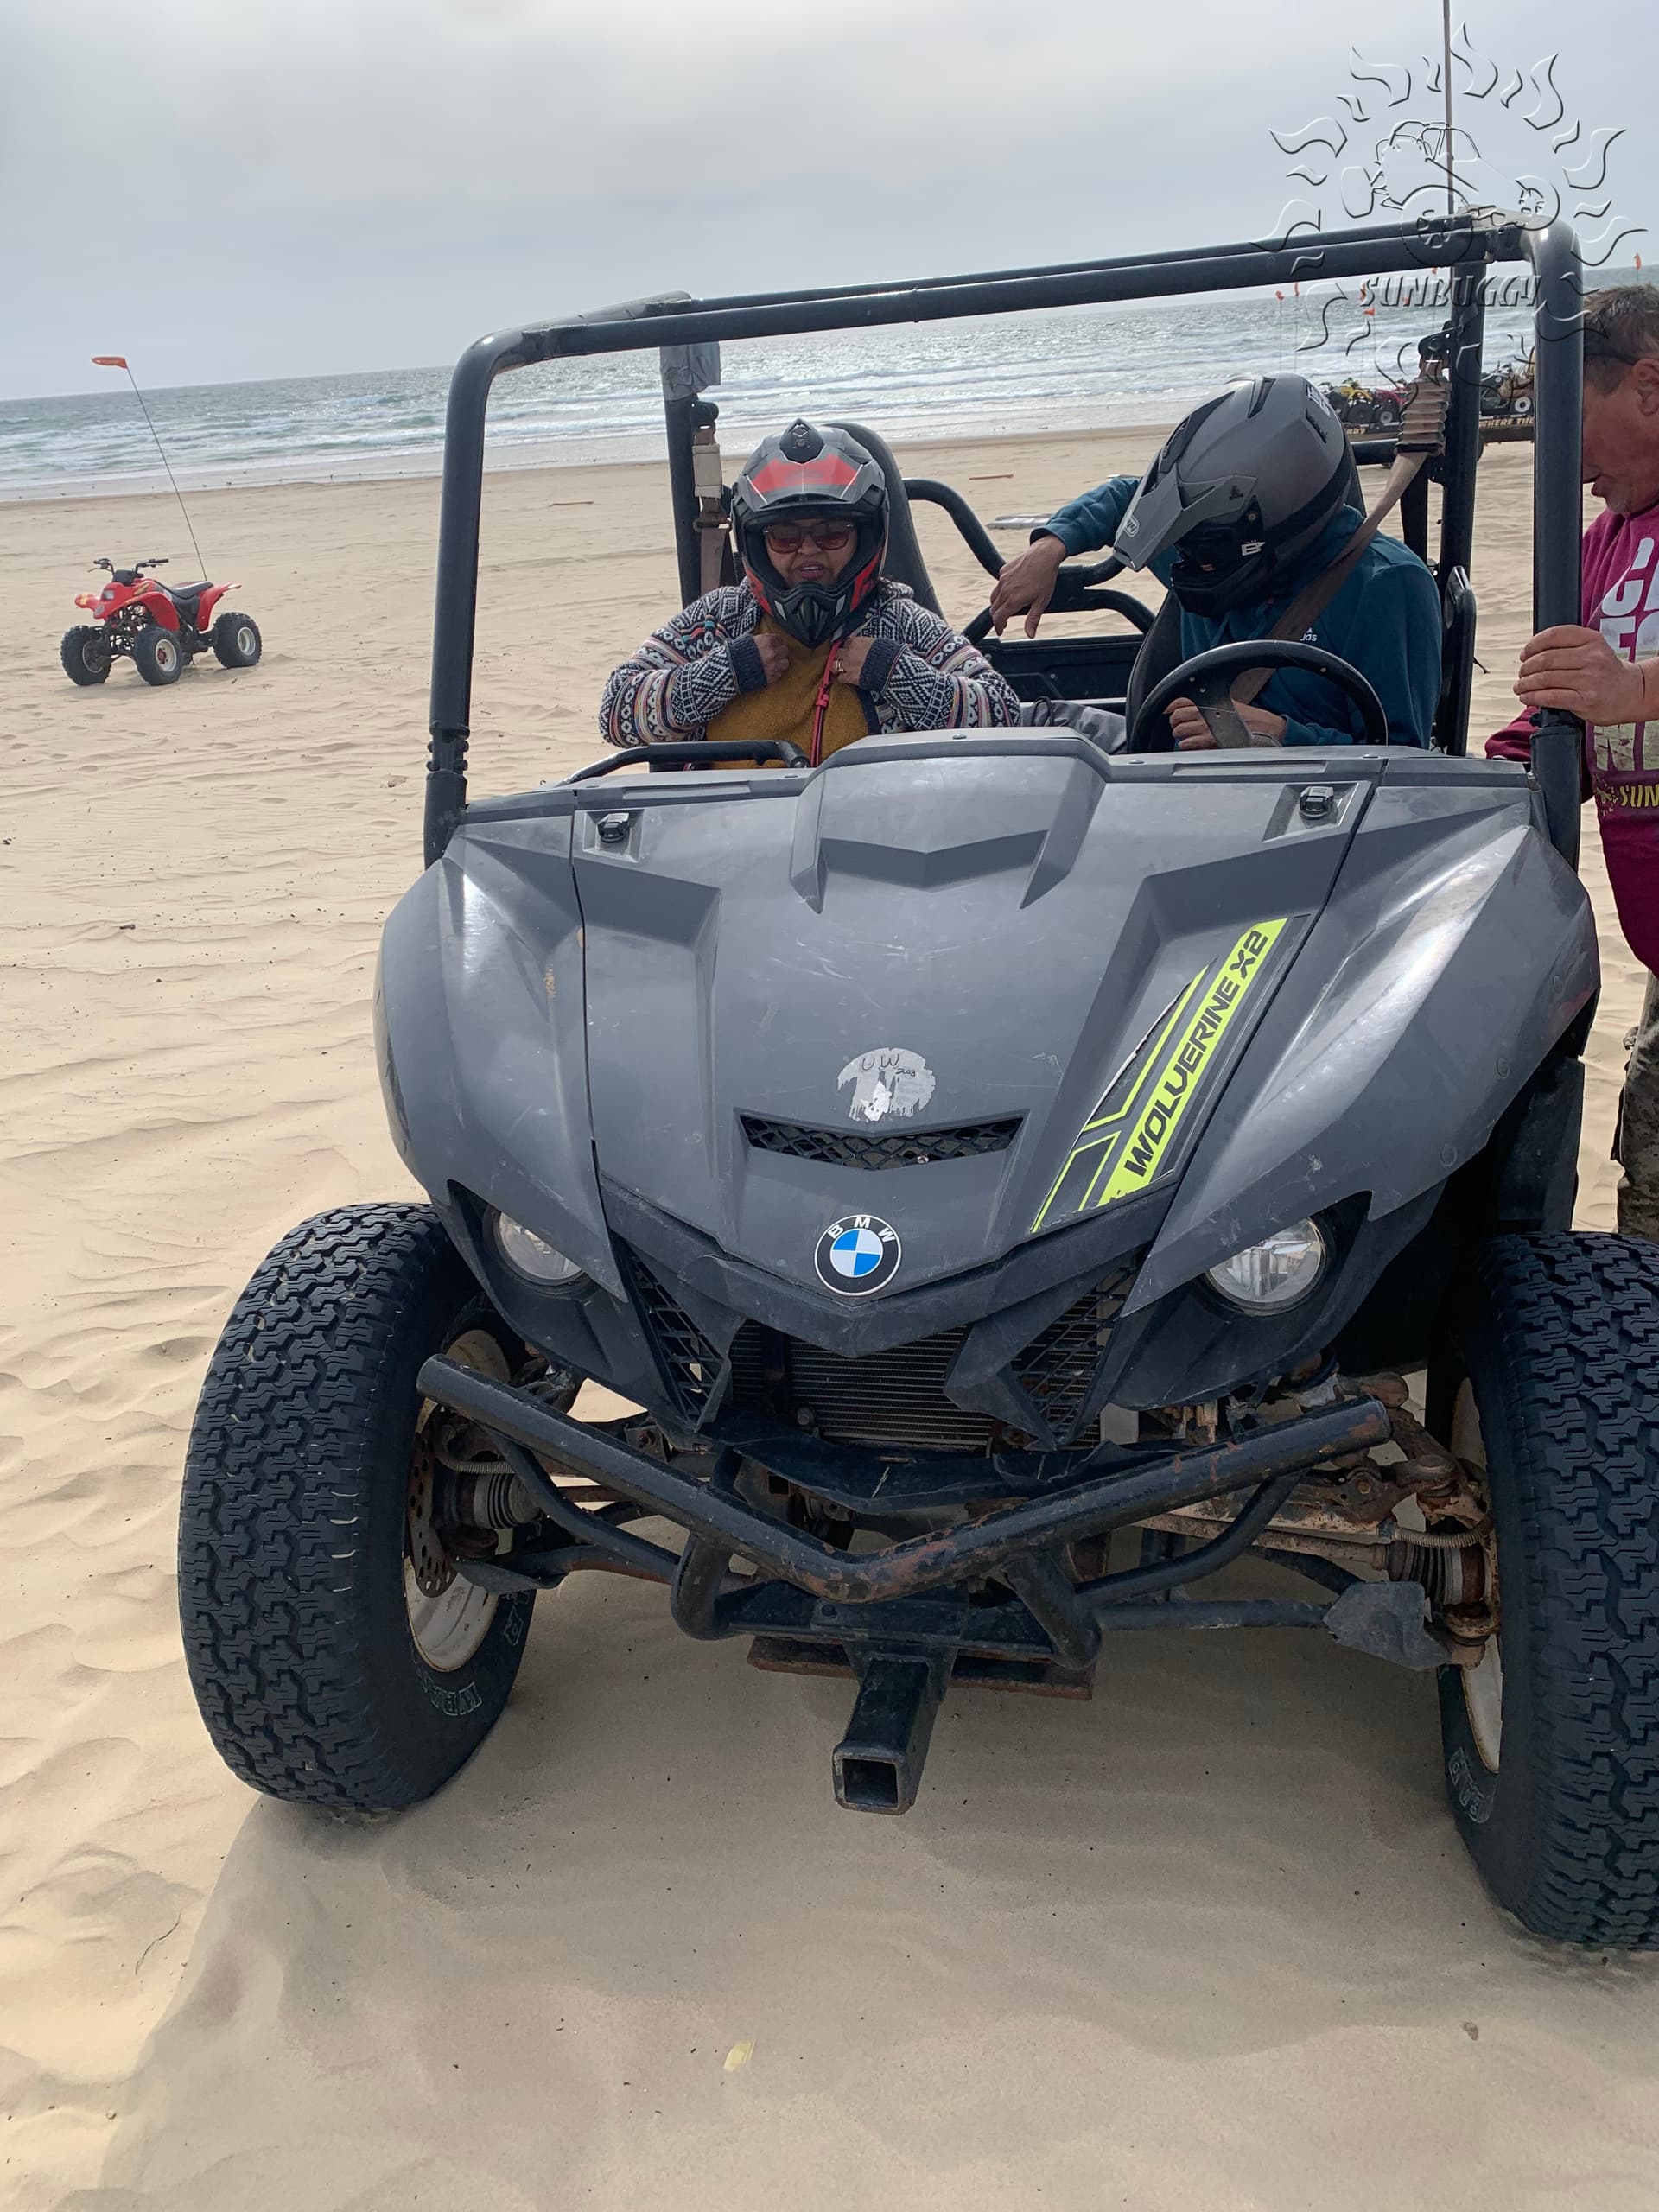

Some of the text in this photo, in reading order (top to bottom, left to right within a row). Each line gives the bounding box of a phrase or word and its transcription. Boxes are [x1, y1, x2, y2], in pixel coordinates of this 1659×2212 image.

[1123, 930, 1269, 1177] WOLVERINE X2
[827, 1217, 896, 1243] BMW
